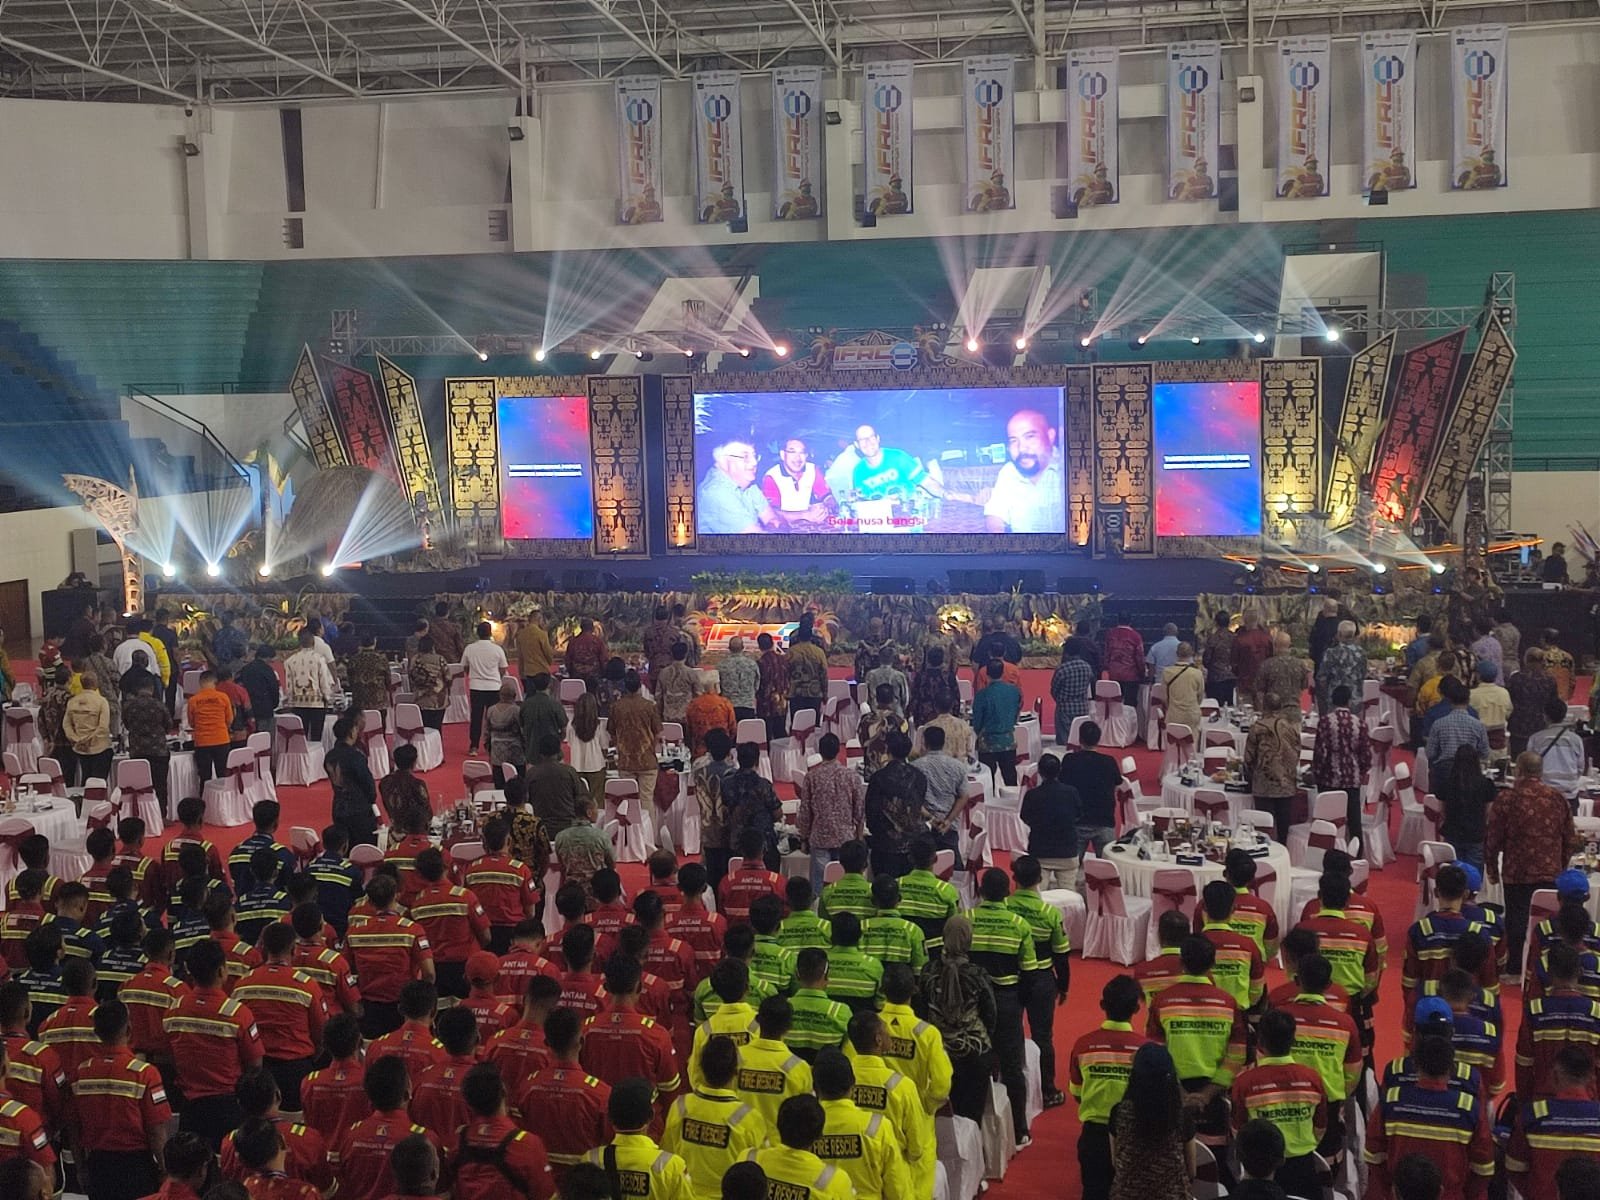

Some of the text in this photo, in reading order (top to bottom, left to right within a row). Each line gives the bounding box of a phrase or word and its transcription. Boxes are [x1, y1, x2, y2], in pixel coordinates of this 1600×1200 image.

[857, 517, 883, 525] nusa
[459, 810, 466, 820] 5
[560, 991, 587, 999] ANTAM
[1170, 1021, 1226, 1029] EMERGENCY
[741, 1072, 783, 1091] FIRE RESCUE
[860, 1086, 884, 1106] RESCUE
[685, 1121, 727, 1144] FIRE RESCUE
[814, 1137, 858, 1156] FIRE RESCUE
[619, 1173, 646, 1194] RESCUE
